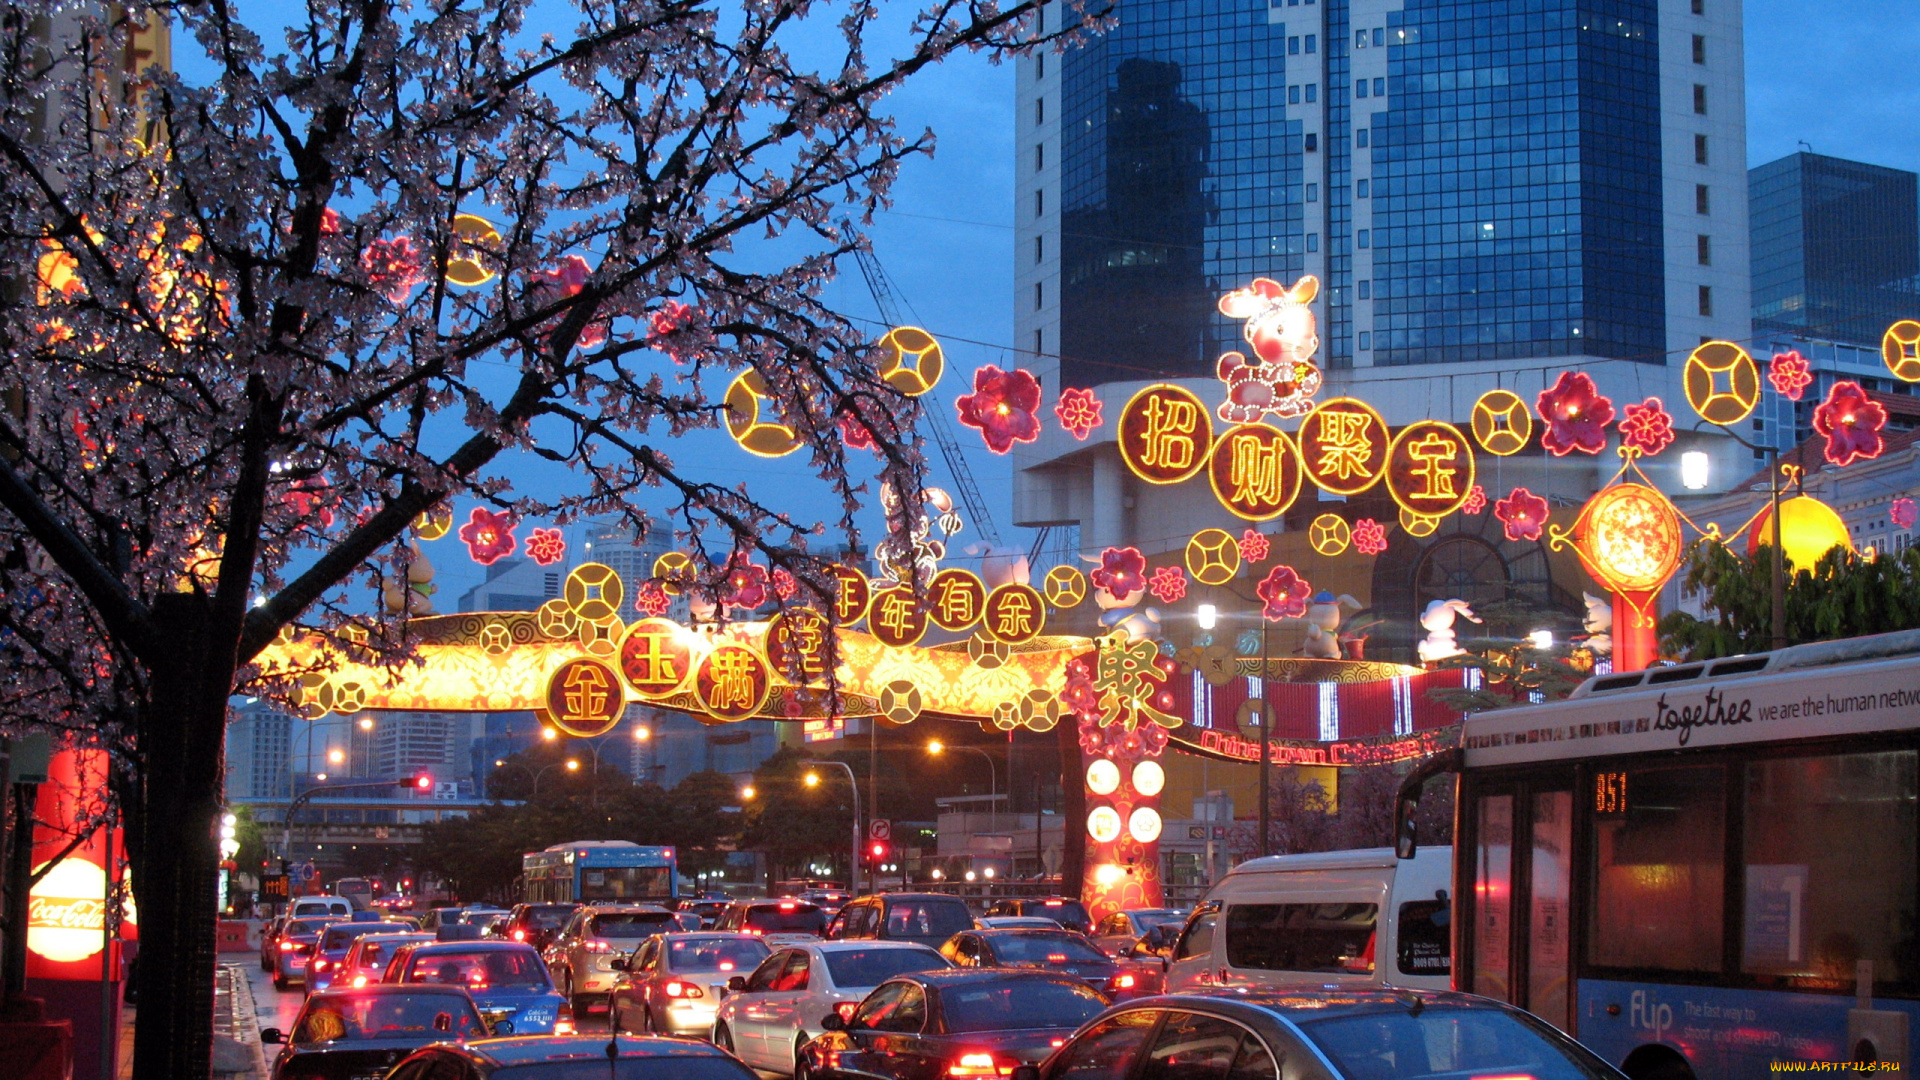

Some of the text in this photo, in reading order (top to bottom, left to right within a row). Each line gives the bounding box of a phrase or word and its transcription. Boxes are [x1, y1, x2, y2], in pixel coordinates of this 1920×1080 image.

[1140, 394, 1458, 506] 招财聚宝
[1758, 707, 1779, 722] we
[1780, 703, 1800, 719] are
[1802, 696, 1824, 717] the
[1826, 693, 1876, 714] human
[1683, 1000, 1757, 1023] The fast way to
[1712, 1028, 1732, 1042] and
[1762, 1030, 1781, 1047] HD
